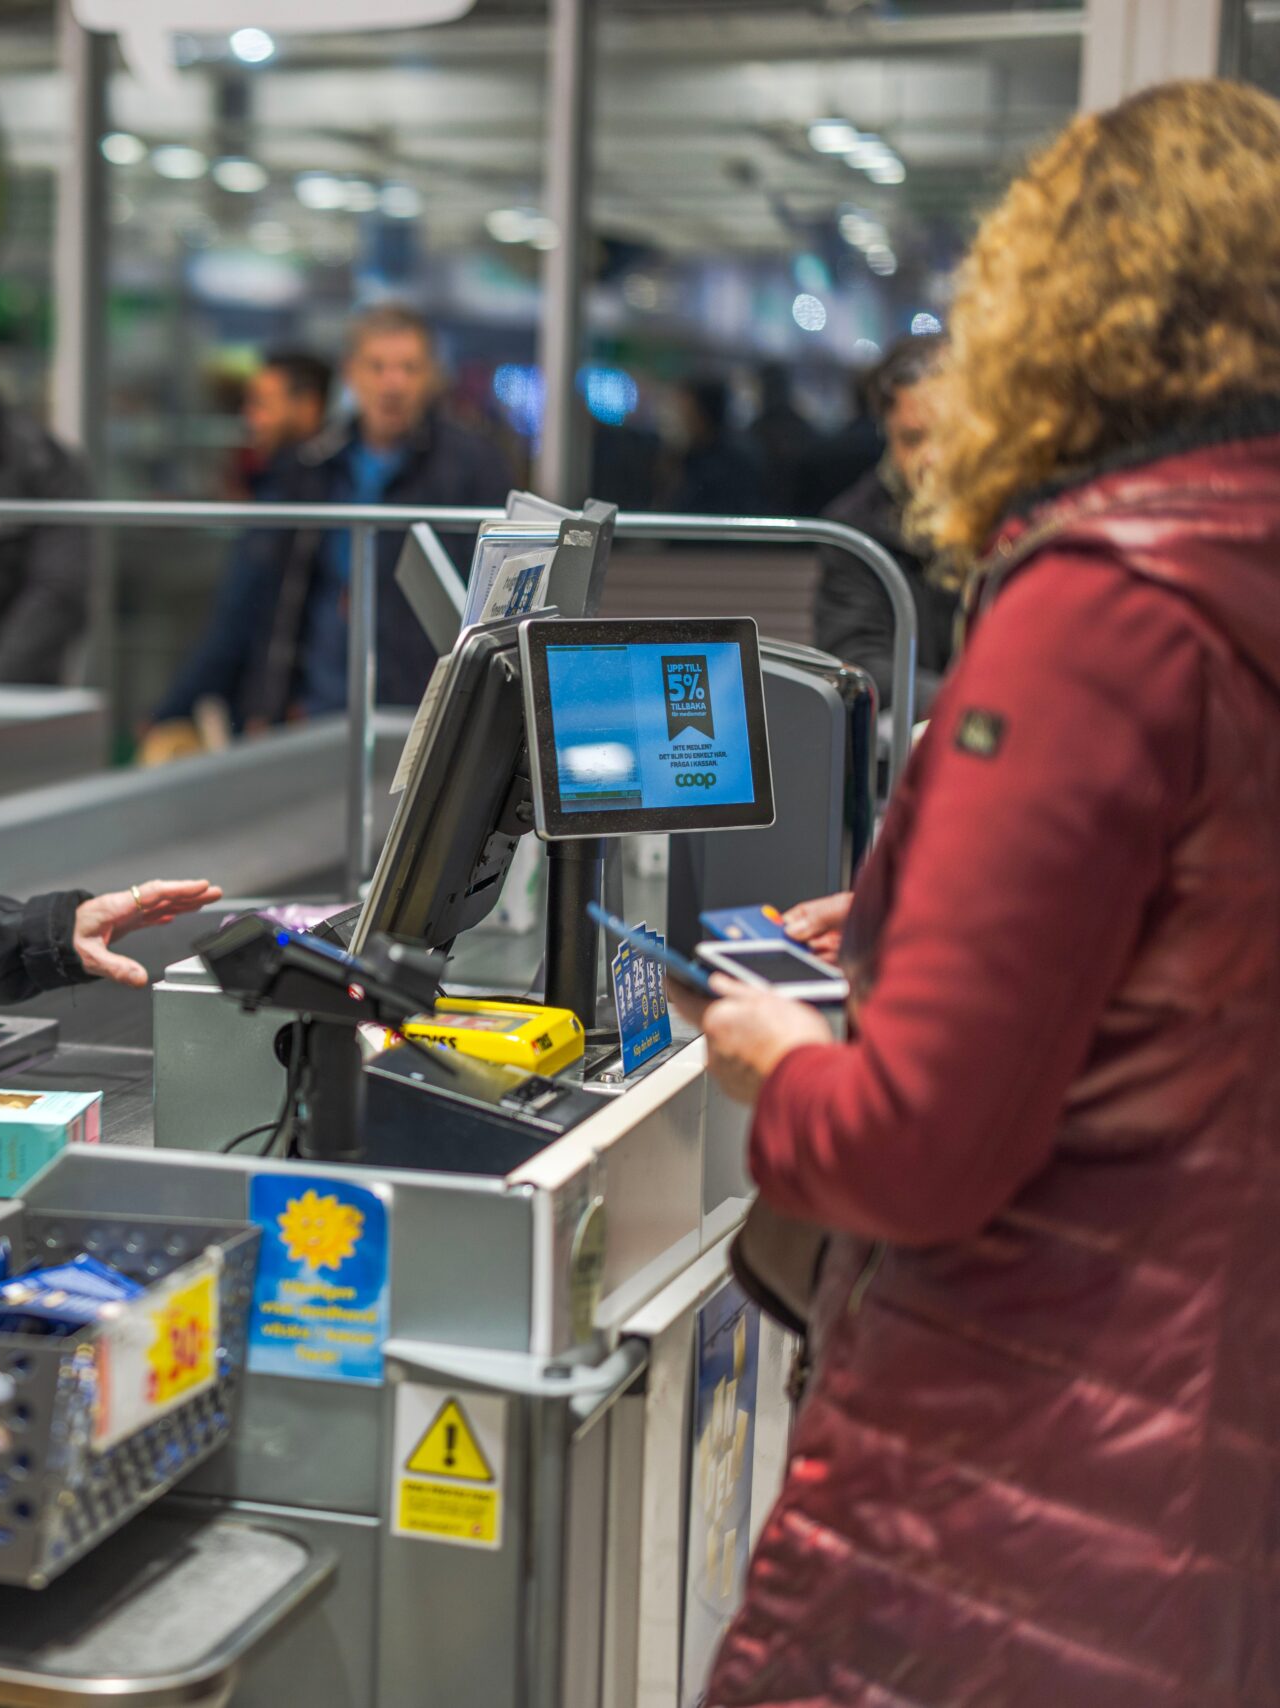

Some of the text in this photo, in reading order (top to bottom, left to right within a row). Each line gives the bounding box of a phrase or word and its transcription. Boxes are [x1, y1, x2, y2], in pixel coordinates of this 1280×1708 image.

[667, 663, 702, 673] UPP TILL
[667, 673, 705, 702] 5%
[671, 702, 707, 711] TILLBAKA
[675, 772, 717, 789] coop
